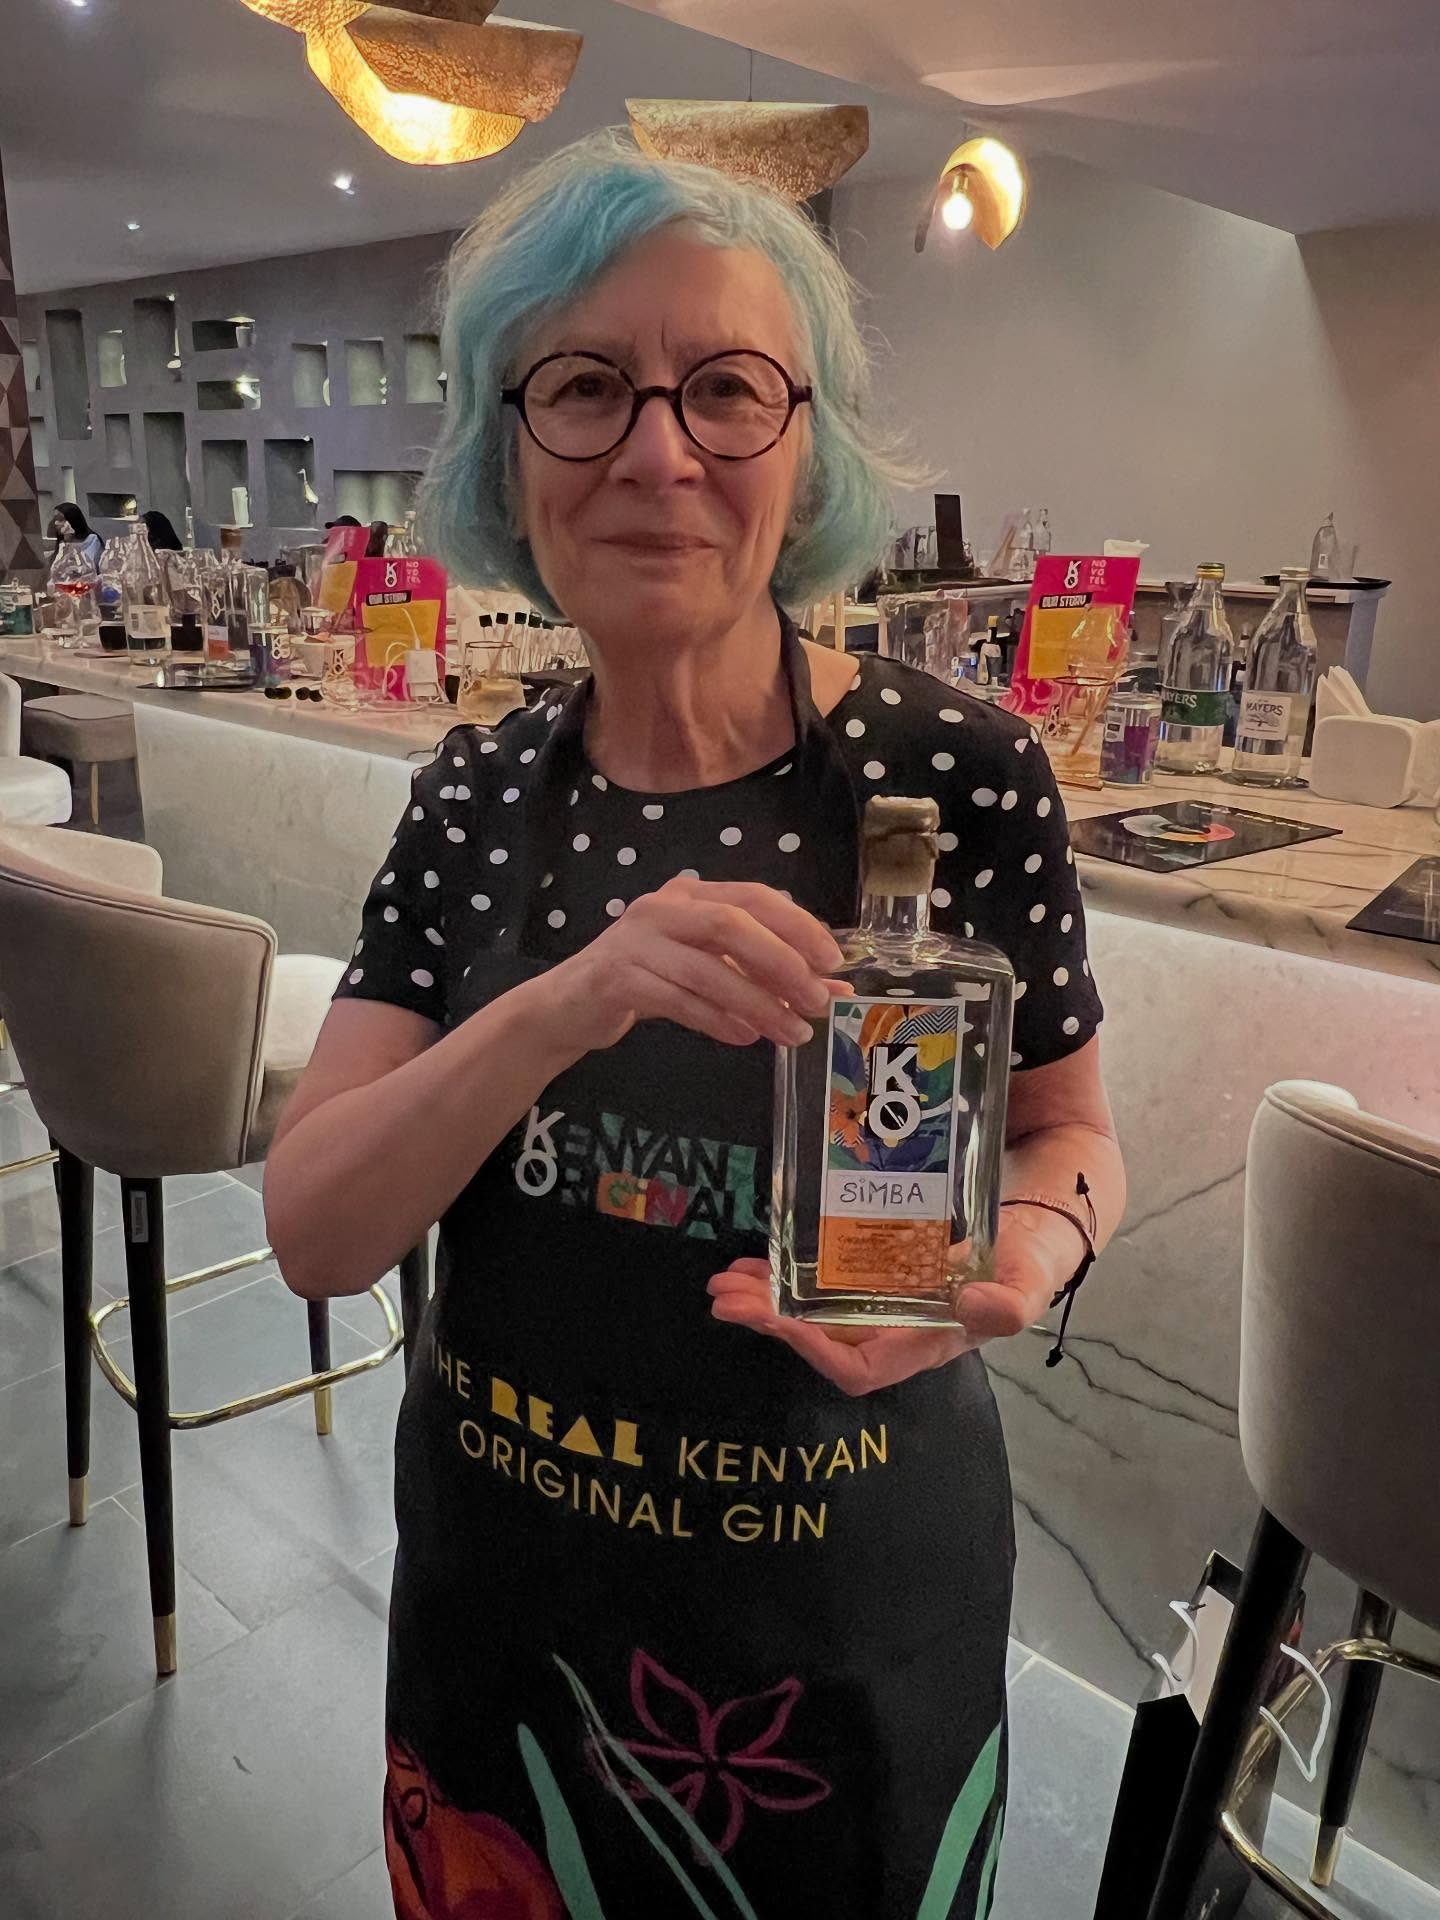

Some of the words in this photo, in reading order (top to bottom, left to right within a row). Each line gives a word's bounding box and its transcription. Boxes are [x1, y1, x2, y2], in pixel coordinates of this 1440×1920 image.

[1041, 596, 1059, 608] OUR
[1059, 594, 1087, 608] STORY
[459, 1419, 693, 1538] ORIGINAL
[723, 1502, 827, 1542] GIN
[491, 1376, 643, 1467] REAL
[679, 1424, 888, 1482] KENYAN
